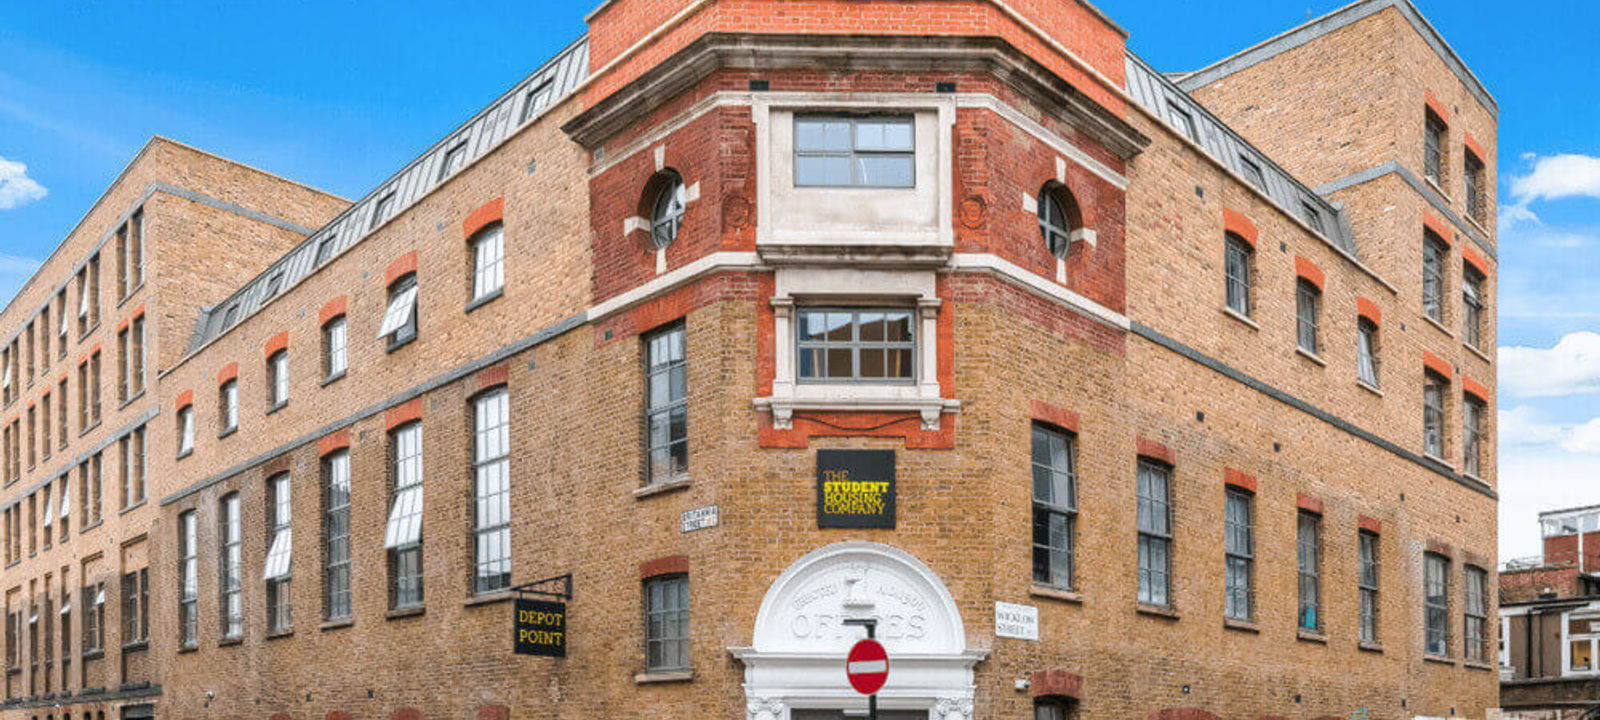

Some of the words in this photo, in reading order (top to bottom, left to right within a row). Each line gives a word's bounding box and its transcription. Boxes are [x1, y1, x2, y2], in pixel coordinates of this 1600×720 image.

[823, 470, 849, 480] THE
[824, 481, 890, 493] STUDENT
[824, 493, 882, 503] HOUSING
[824, 503, 886, 515] COMPANY
[519, 610, 563, 626] DEPOT
[791, 614, 928, 639] OFFCES
[519, 629, 563, 646] POINT
